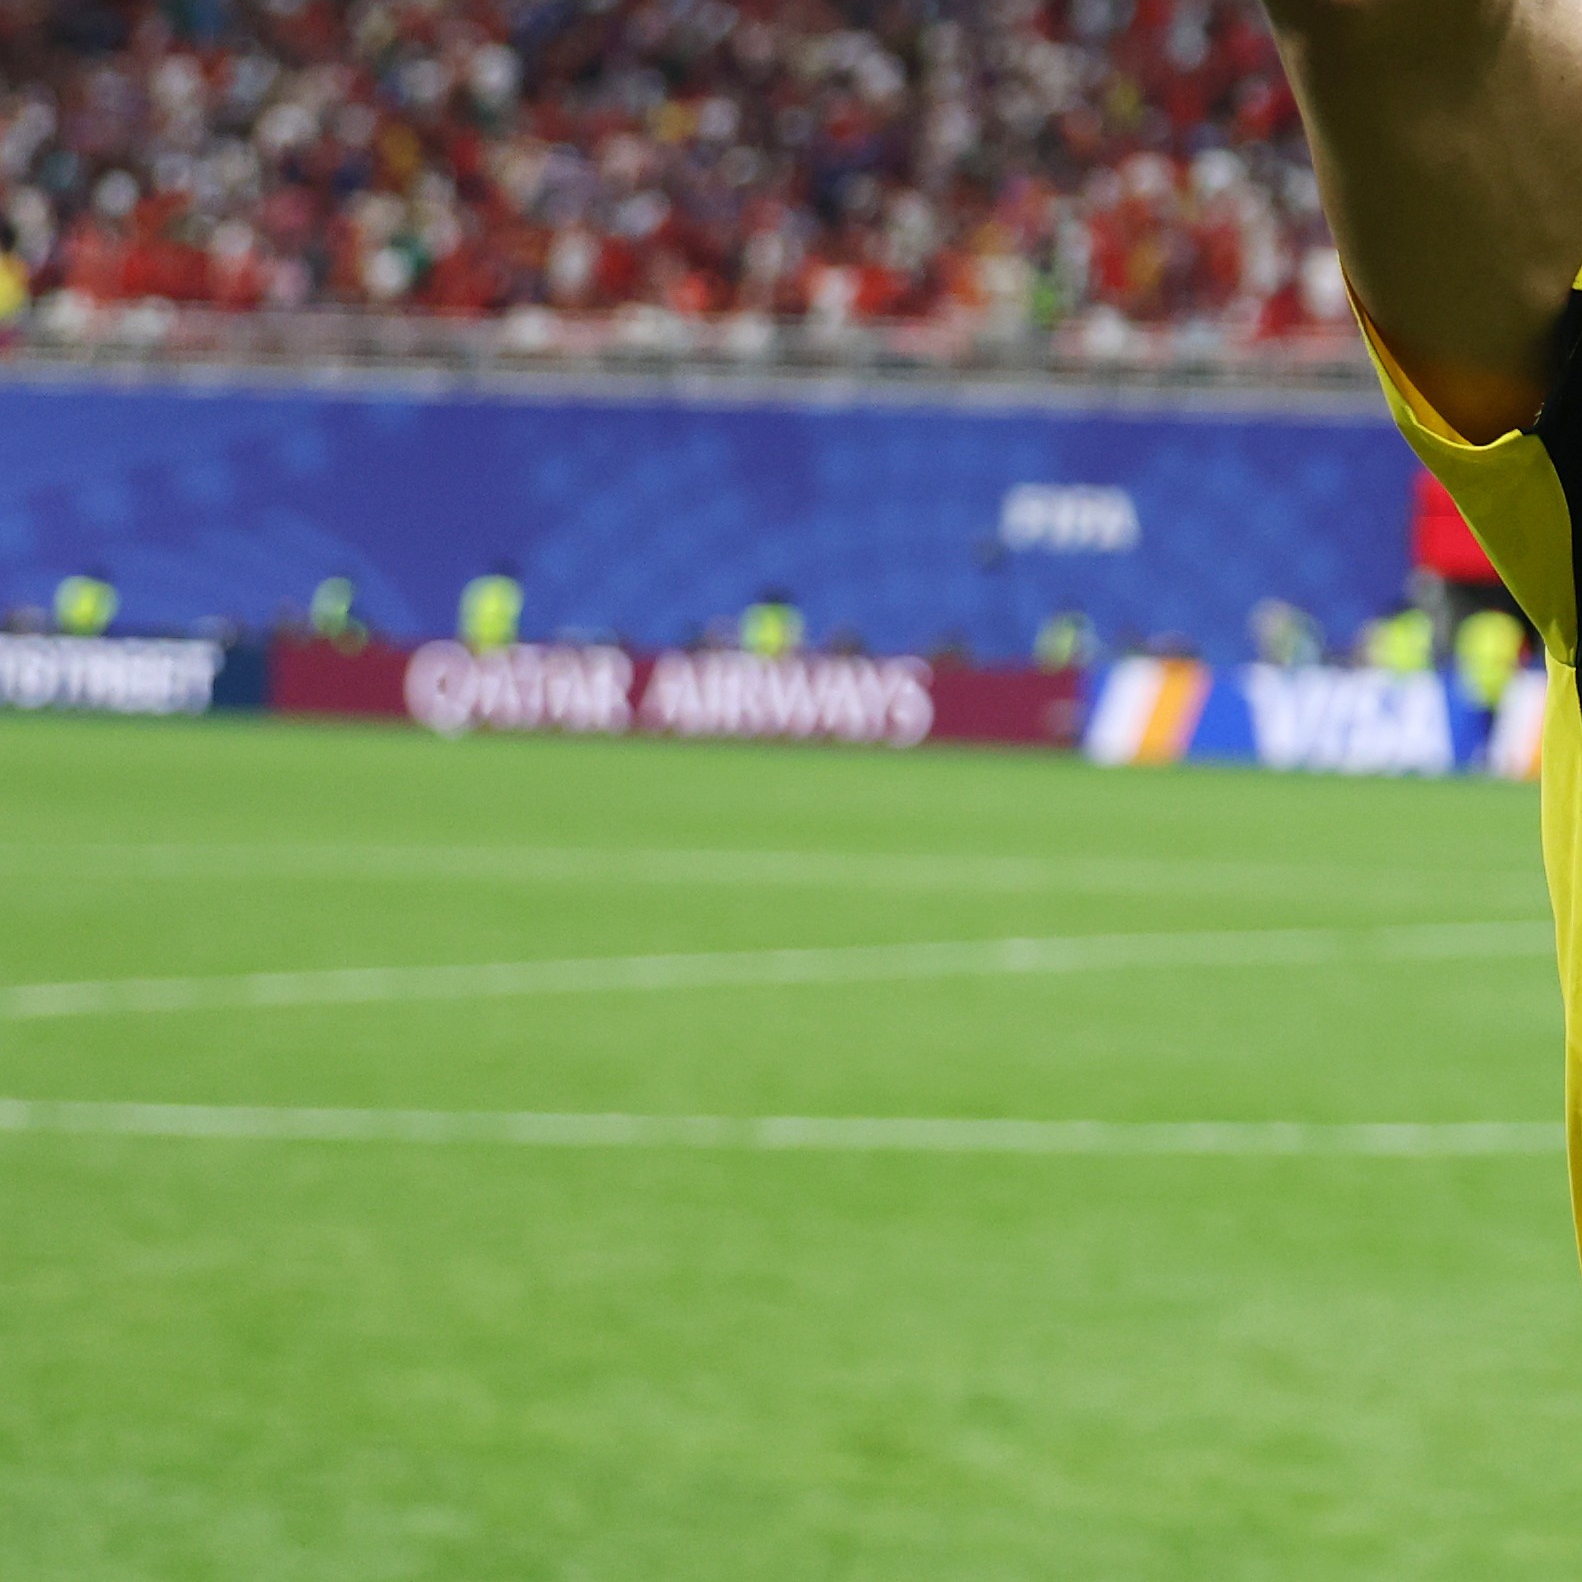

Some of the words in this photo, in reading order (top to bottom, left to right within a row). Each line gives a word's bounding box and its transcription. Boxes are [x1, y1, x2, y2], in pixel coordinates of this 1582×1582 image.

[404, 639, 635, 738] QATAR
[642, 649, 934, 747] AIRWAYS
[1243, 664, 1455, 773] VISA
